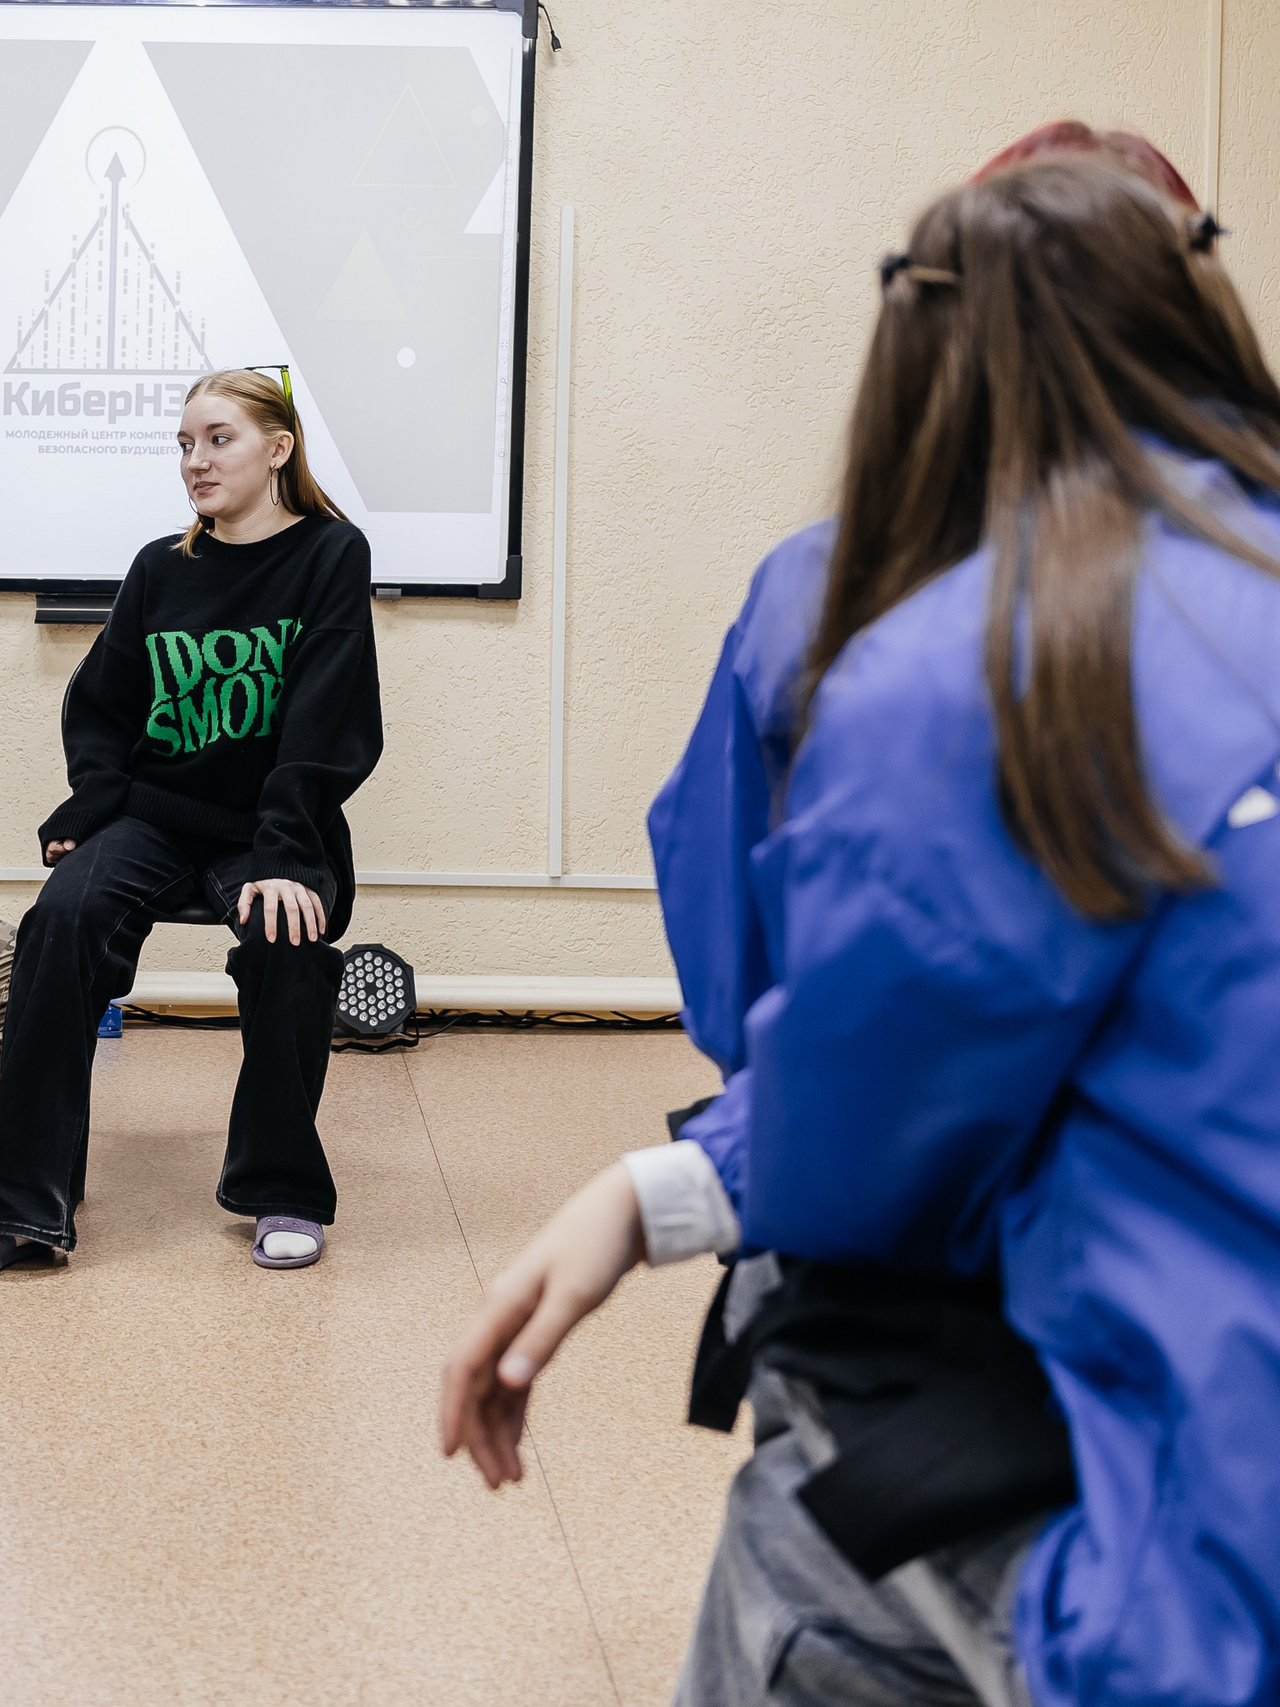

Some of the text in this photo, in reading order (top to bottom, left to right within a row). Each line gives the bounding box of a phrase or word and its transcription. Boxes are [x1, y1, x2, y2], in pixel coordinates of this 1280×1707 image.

[3, 381, 194, 425] КиберНЭ
[5, 428, 179, 441] МОЛОДЕЖНЫЙ ЦЕНТР КОМПЕТ
[37, 444, 180, 456] БЕЗОПАСНОГО БУДУЩЕГО
